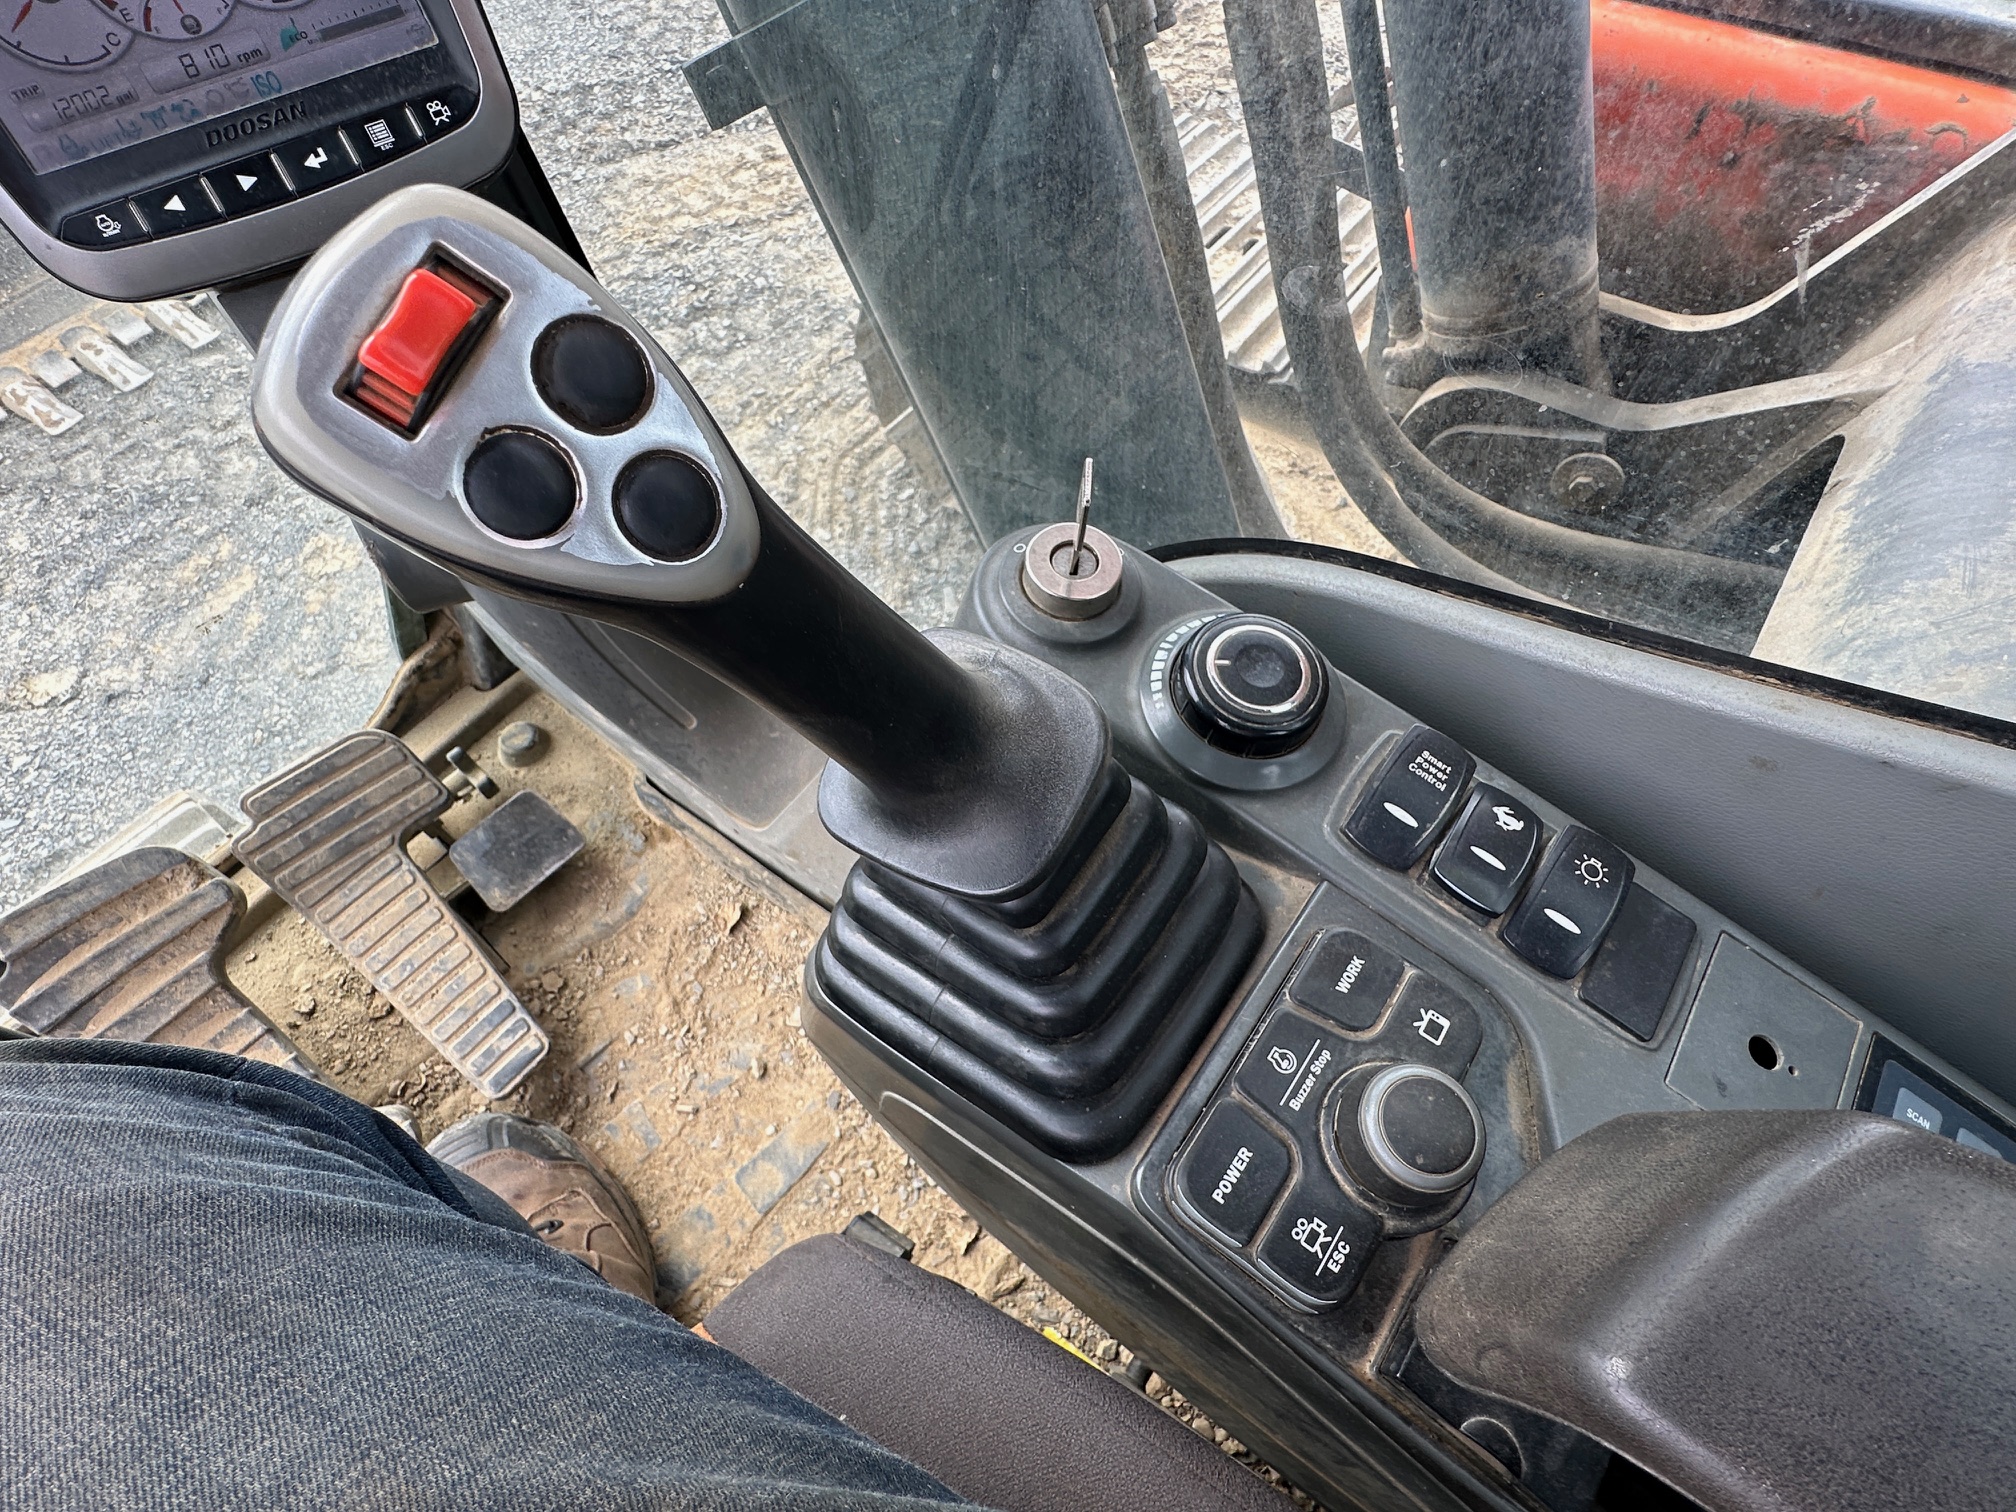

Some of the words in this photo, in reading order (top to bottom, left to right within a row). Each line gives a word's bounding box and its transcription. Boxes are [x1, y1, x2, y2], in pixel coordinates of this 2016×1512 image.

[119, 7, 135, 23] E
[105, 32, 121, 47] C
[178, 43, 231, 79] 810
[236, 46, 264, 63] rpm
[11, 84, 40, 101] TRIP
[250, 70, 283, 99] ISO
[52, 85, 111, 121] 12002
[206, 101, 308, 148] DOOSAN
[1414, 756, 1449, 781] Power
[1421, 750, 1452, 774] Smart
[1408, 763, 1447, 792] Control
[1335, 955, 1366, 994] WORK
[1288, 1073, 1317, 1112] Buzzer
[1310, 1049, 1332, 1075] Stop
[1906, 1107, 1931, 1130] SCAN
[1211, 1146, 1254, 1205] POWER
[1326, 1240, 1351, 1274] ESC
